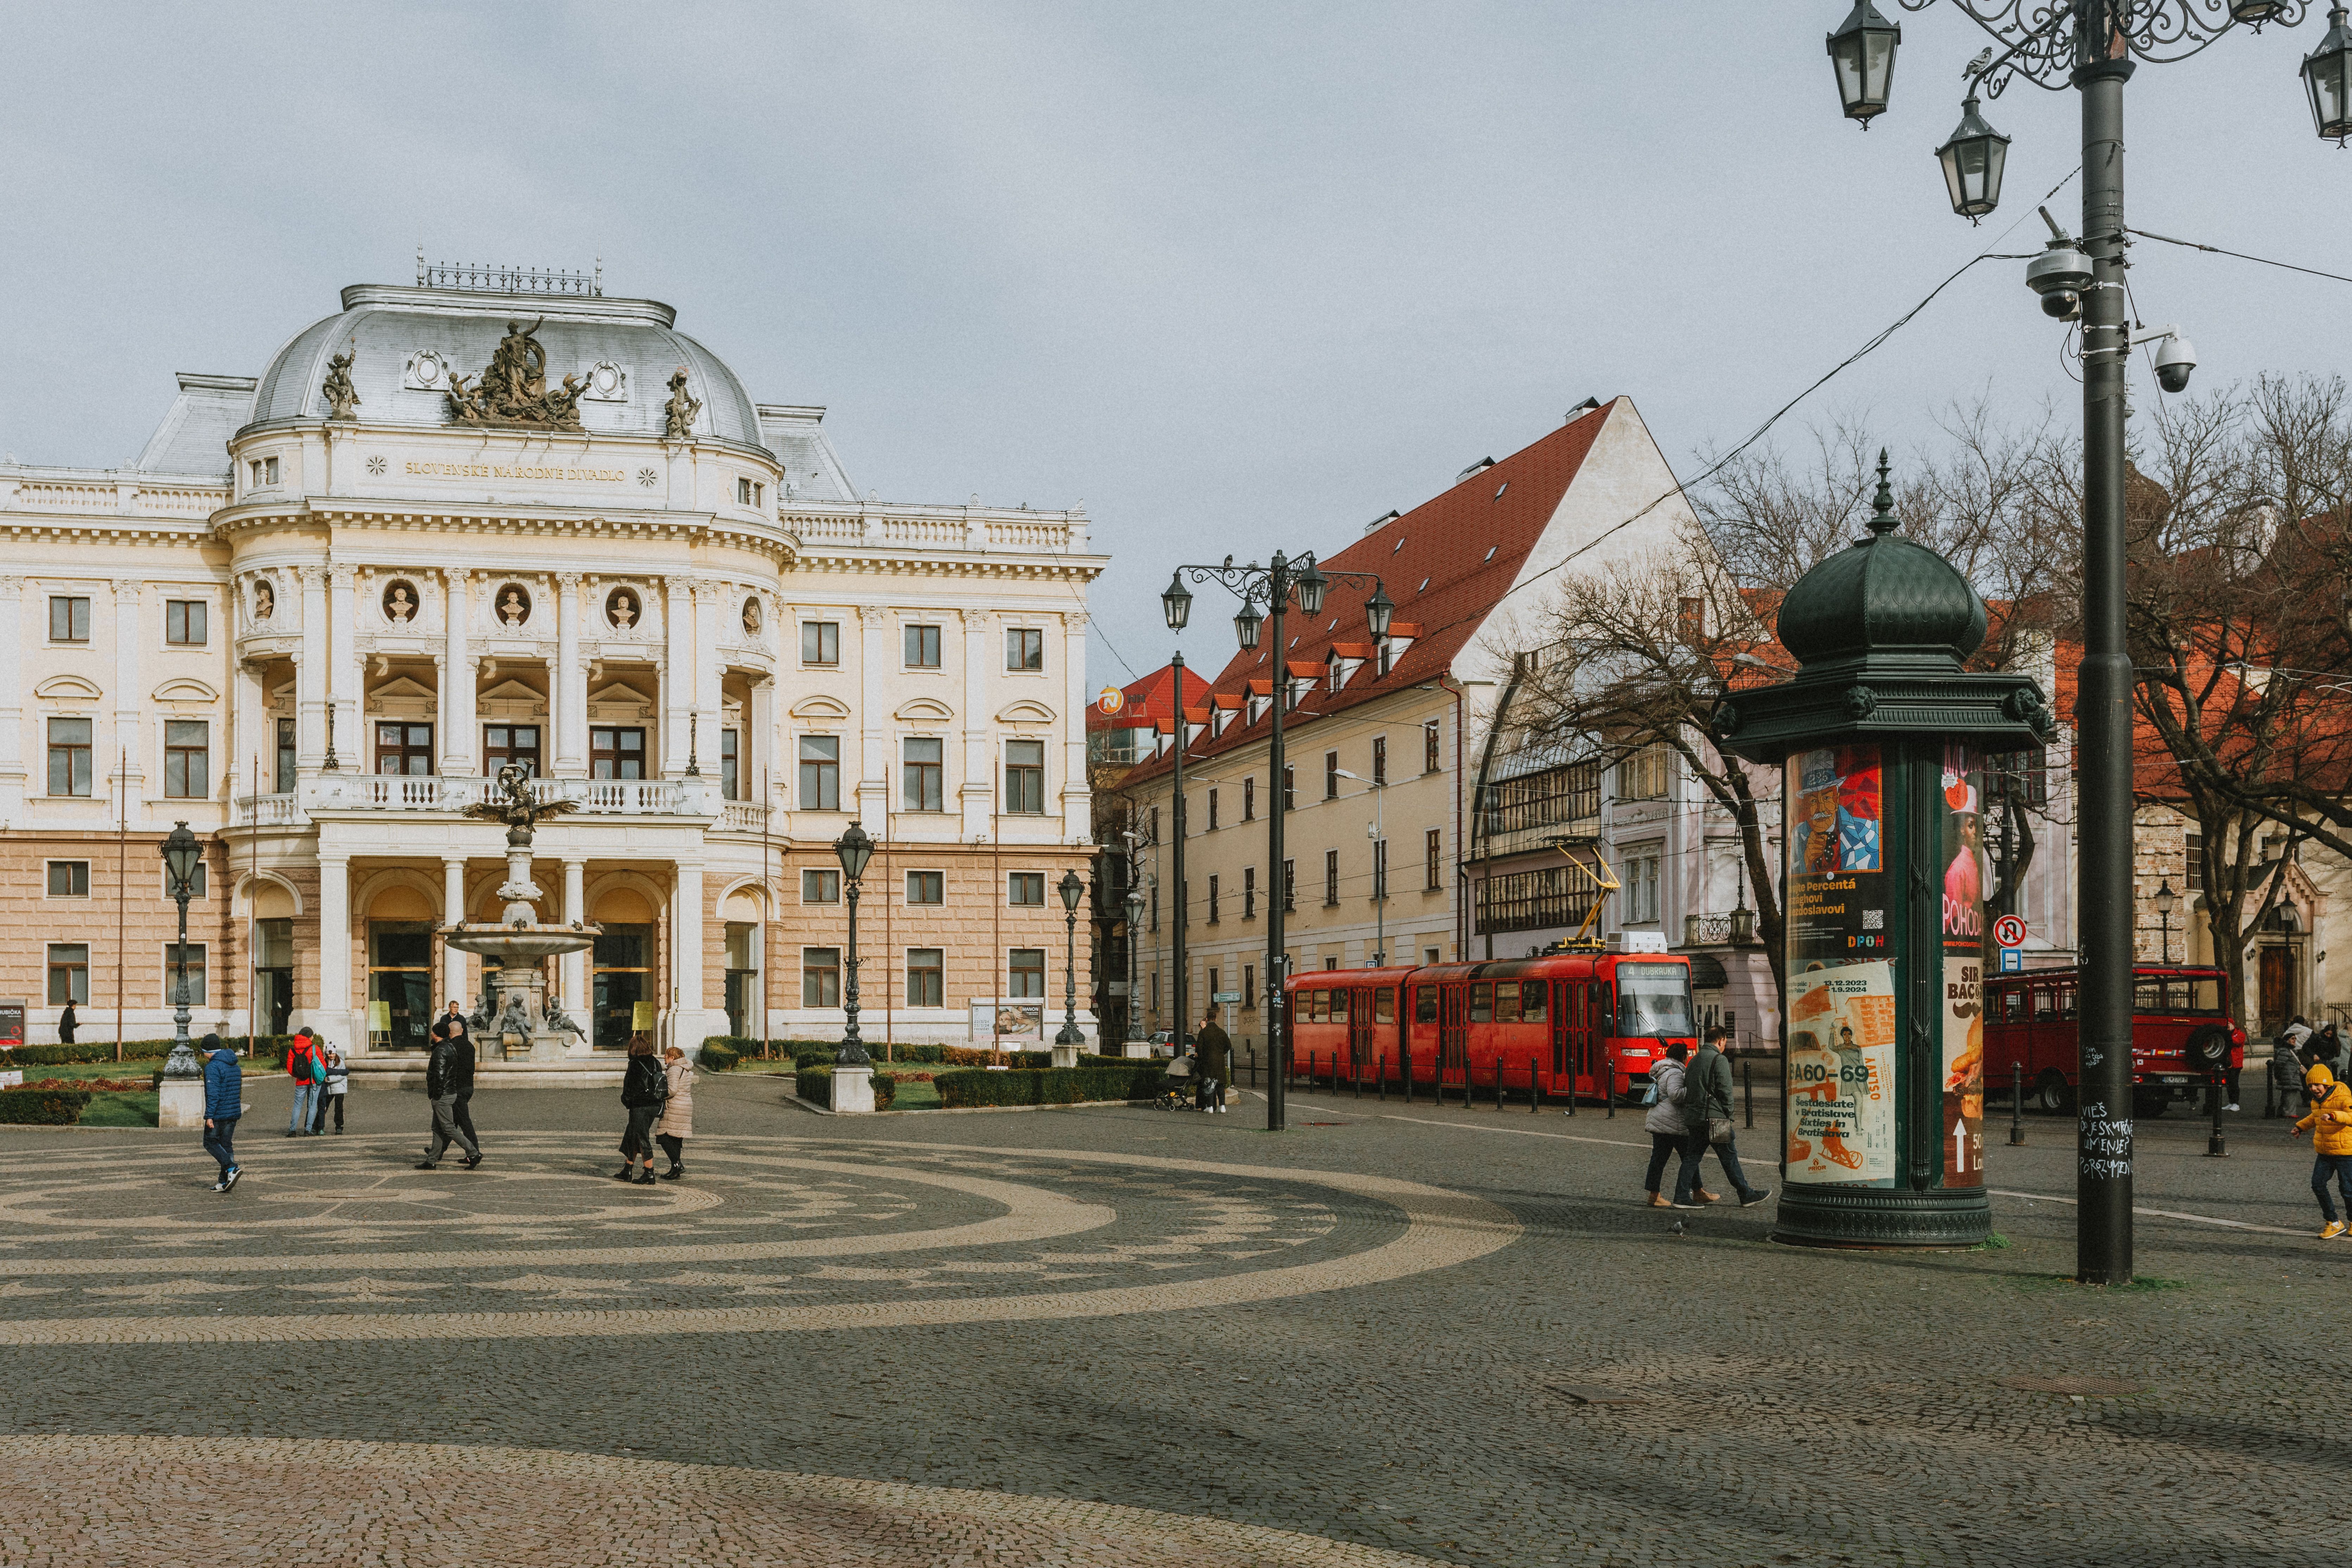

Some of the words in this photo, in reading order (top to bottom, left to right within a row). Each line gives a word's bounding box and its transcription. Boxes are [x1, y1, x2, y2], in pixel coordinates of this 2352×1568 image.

[406, 462, 488, 477] SLOVENSKÉ
[494, 465, 563, 480] NÁRODNÉ
[568, 469, 625, 481] DIVADLO
[1127, 694, 1145, 703] NN
[1807, 878, 1856, 891] Percentá
[1942, 893, 1982, 936] POHODA
[1848, 935, 1883, 947] DPOH
[1628, 966, 1634, 976] 4
[1961, 966, 1979, 982] SIR
[1865, 1058, 1881, 1100] OSLAVY
[1796, 1096, 1854, 1108] Šesťdesiate
[1801, 1109, 1855, 1118] Bratislave
[2082, 1102, 2107, 1118] VIEŠ
[1800, 1118, 1832, 1127] Sixties
[1835, 1119, 1846, 1128] in
[1798, 1128, 1850, 1138] Bratislava
